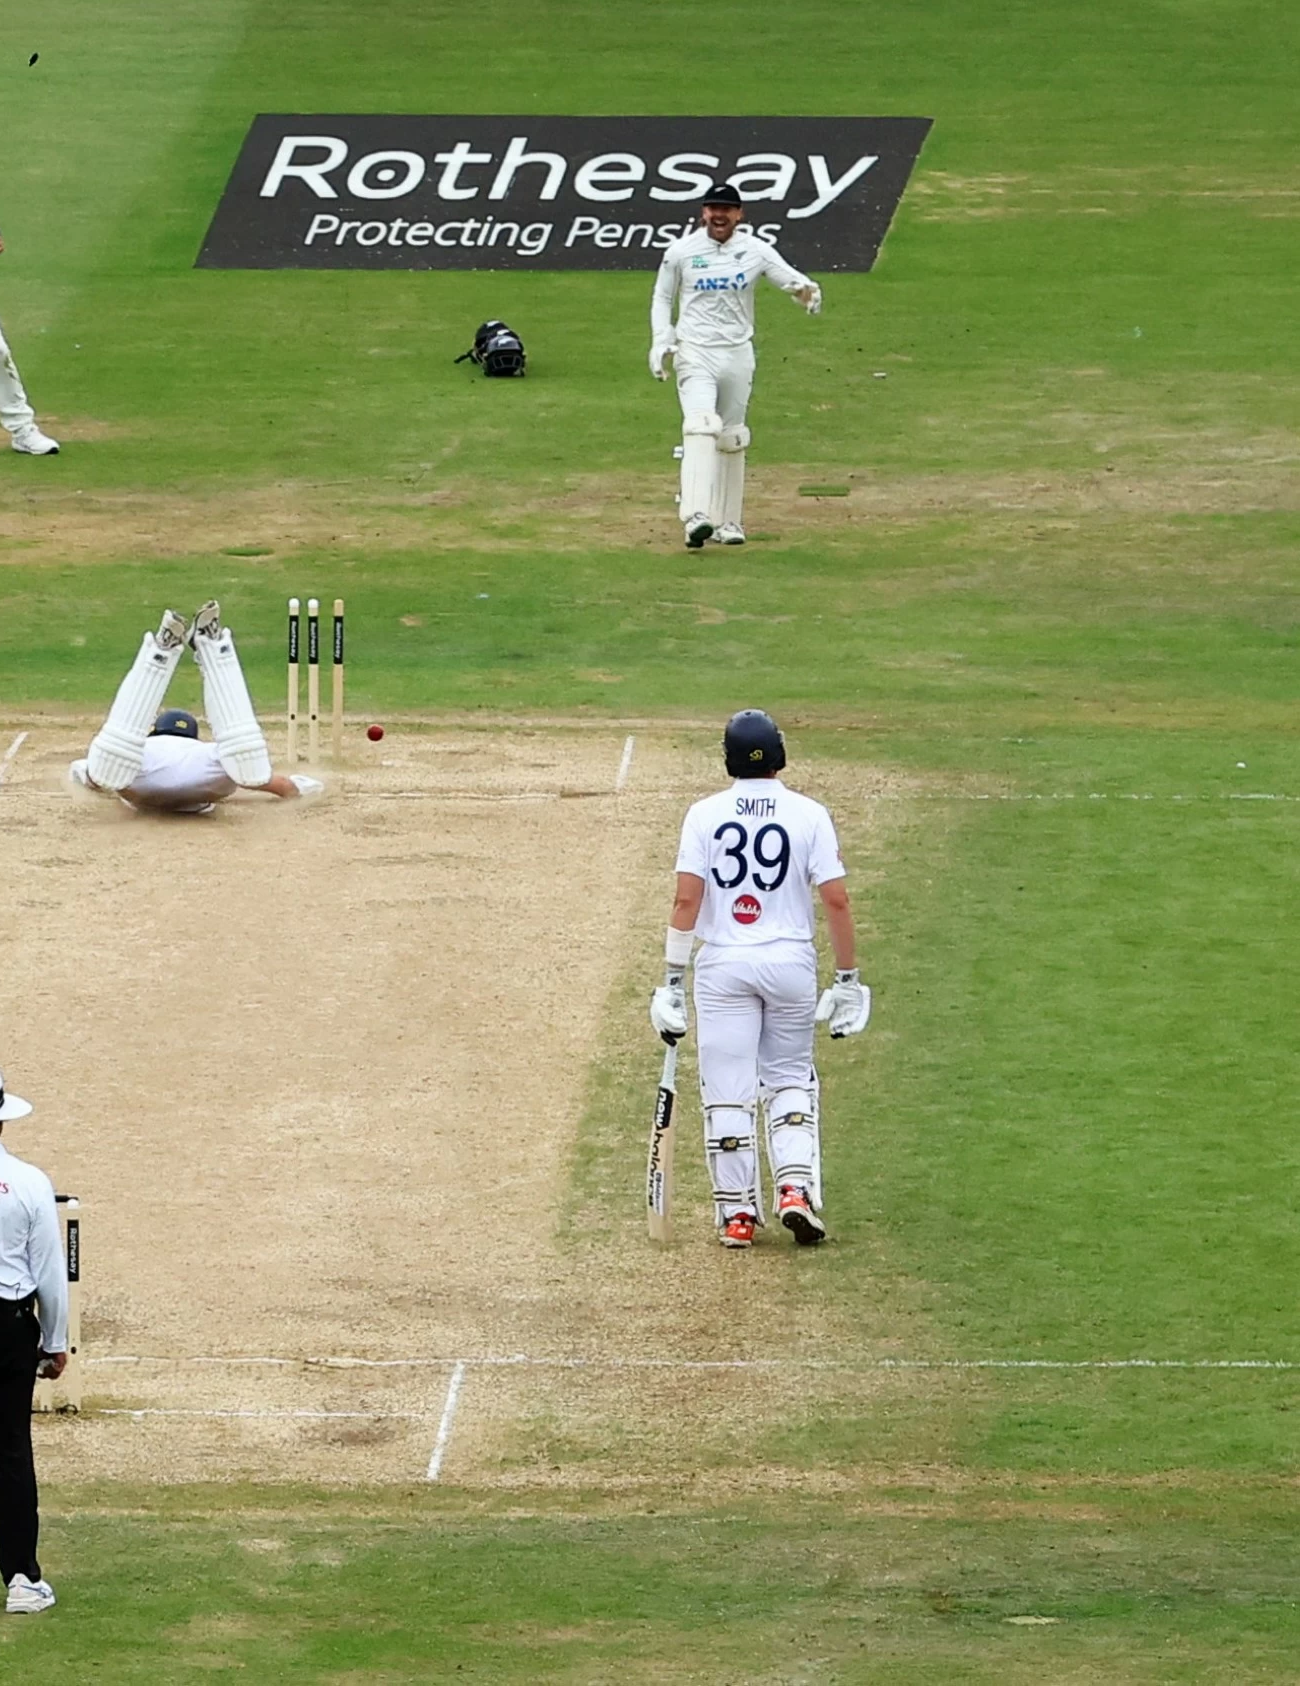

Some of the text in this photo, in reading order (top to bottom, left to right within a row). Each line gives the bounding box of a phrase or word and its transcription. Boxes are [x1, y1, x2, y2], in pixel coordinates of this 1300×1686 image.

[259, 136, 879, 218] Rothesay
[304, 214, 783, 256] Protecting Pensis
[694, 277, 730, 290] ANZ
[735, 797, 777, 817] SMITH
[711, 821, 791, 892] 39
[655, 1091, 667, 1128] new
[69, 1227, 78, 1275] Rothesay
